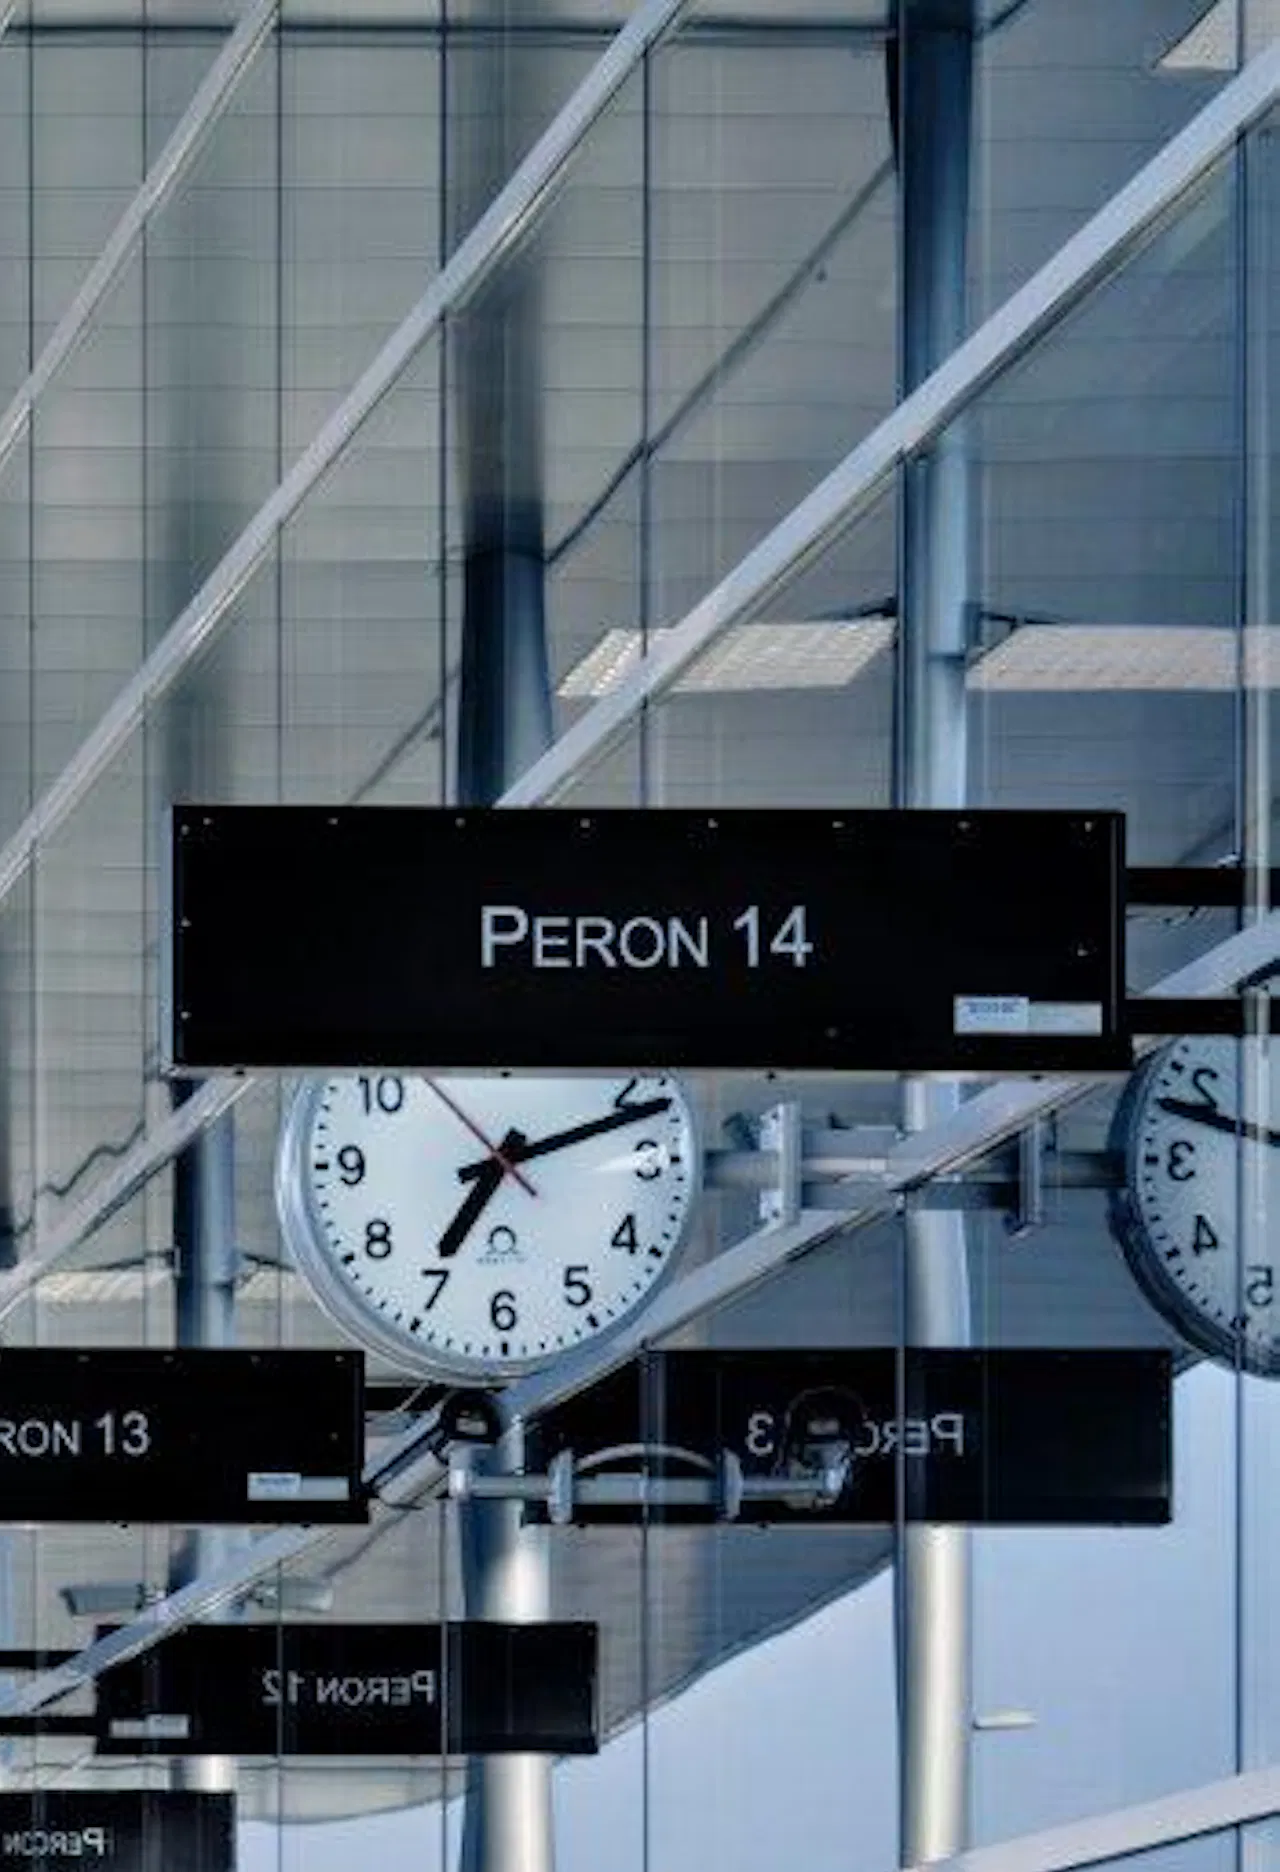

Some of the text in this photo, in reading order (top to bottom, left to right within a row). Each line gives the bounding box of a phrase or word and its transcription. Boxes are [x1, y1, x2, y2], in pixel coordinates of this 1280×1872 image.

[481, 905, 813, 968] PERON 14
[358, 1076, 403, 1115] 10
[340, 1145, 366, 1186] 9
[365, 1219, 392, 1258] 8
[611, 1214, 639, 1254] 4
[421, 1269, 450, 1311] 7
[563, 1266, 592, 1307] 5
[490, 1291, 517, 1331] 6
[96, 1411, 150, 1455] 13
